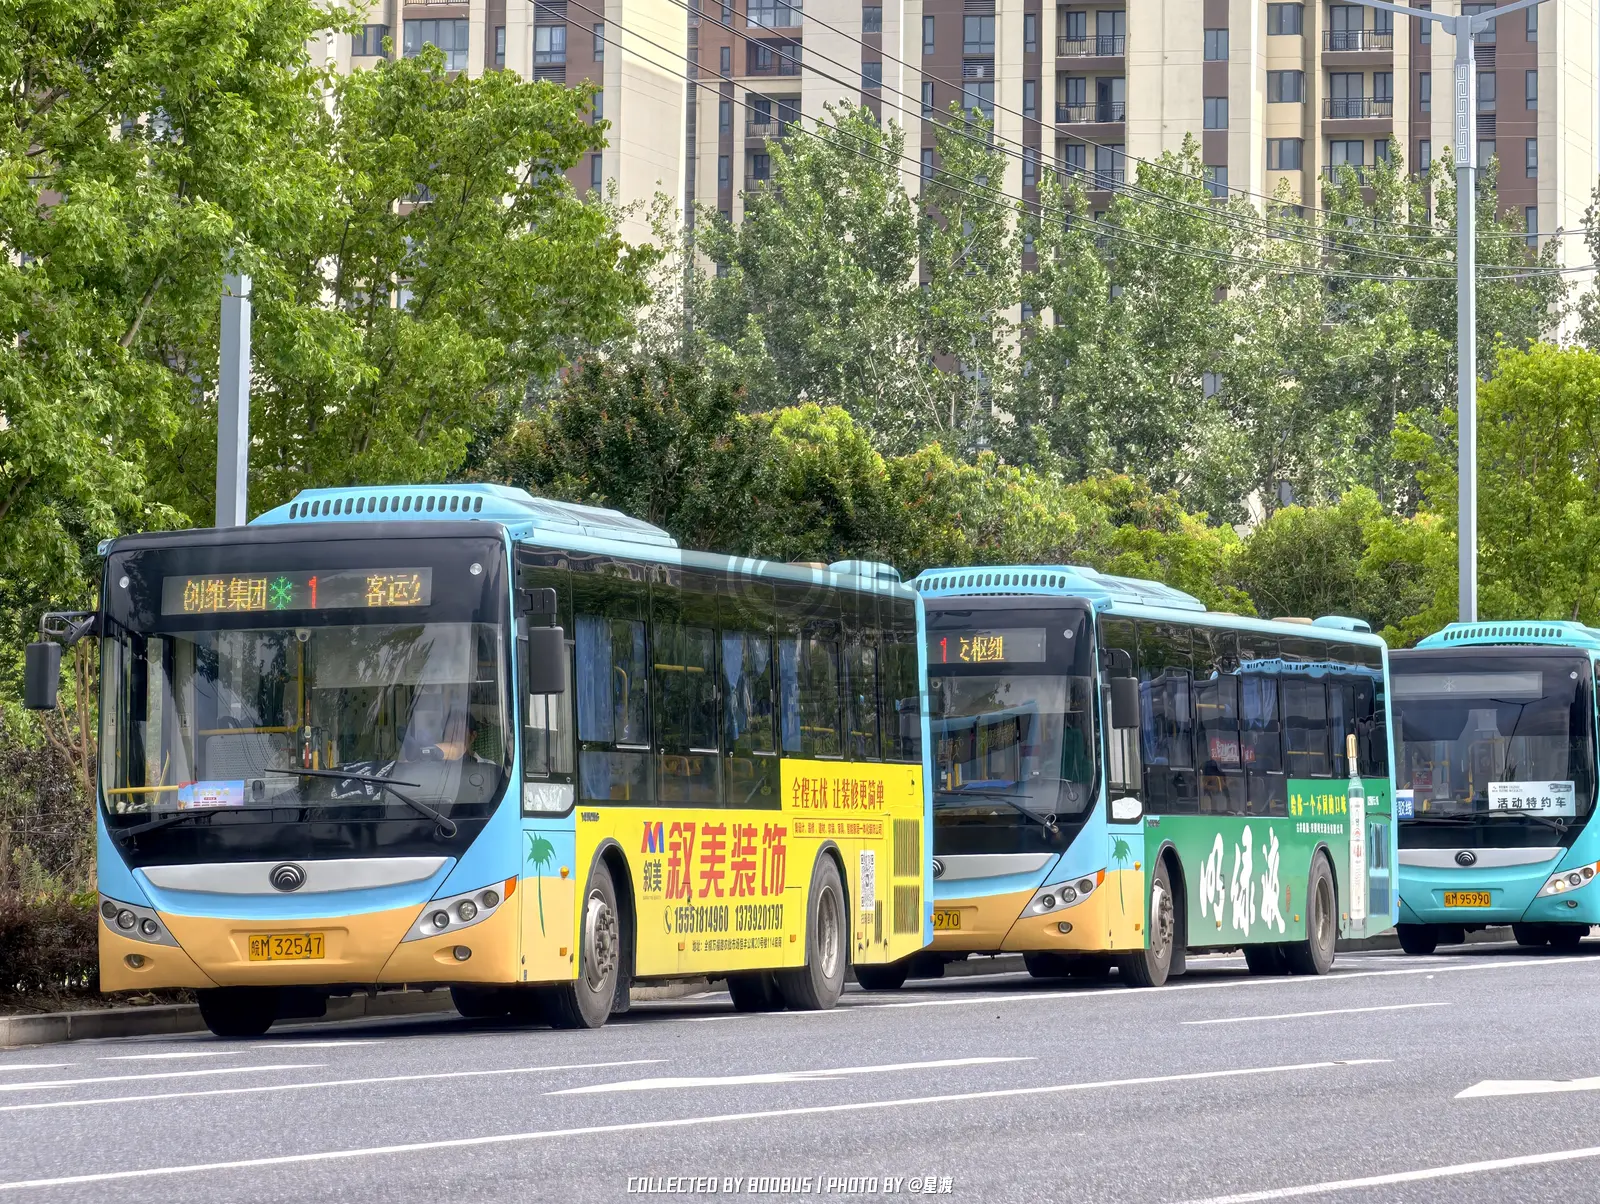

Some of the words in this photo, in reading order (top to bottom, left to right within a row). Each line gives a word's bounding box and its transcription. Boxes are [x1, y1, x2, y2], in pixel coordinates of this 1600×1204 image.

[183, 577, 267, 612] 创维集团
[939, 636, 947, 664] 1
[792, 777, 828, 809] 全程无忧
[833, 778, 885, 810] 让装修更简单
[1497, 796, 1567, 809] 活动特约车
[643, 859, 662, 892] 叙美
[665, 821, 788, 899] 叙美装饰
[675, 905, 729, 933] 15551814960
[735, 903, 783, 931] 13739201797
[933, 913, 959, 926] 970
